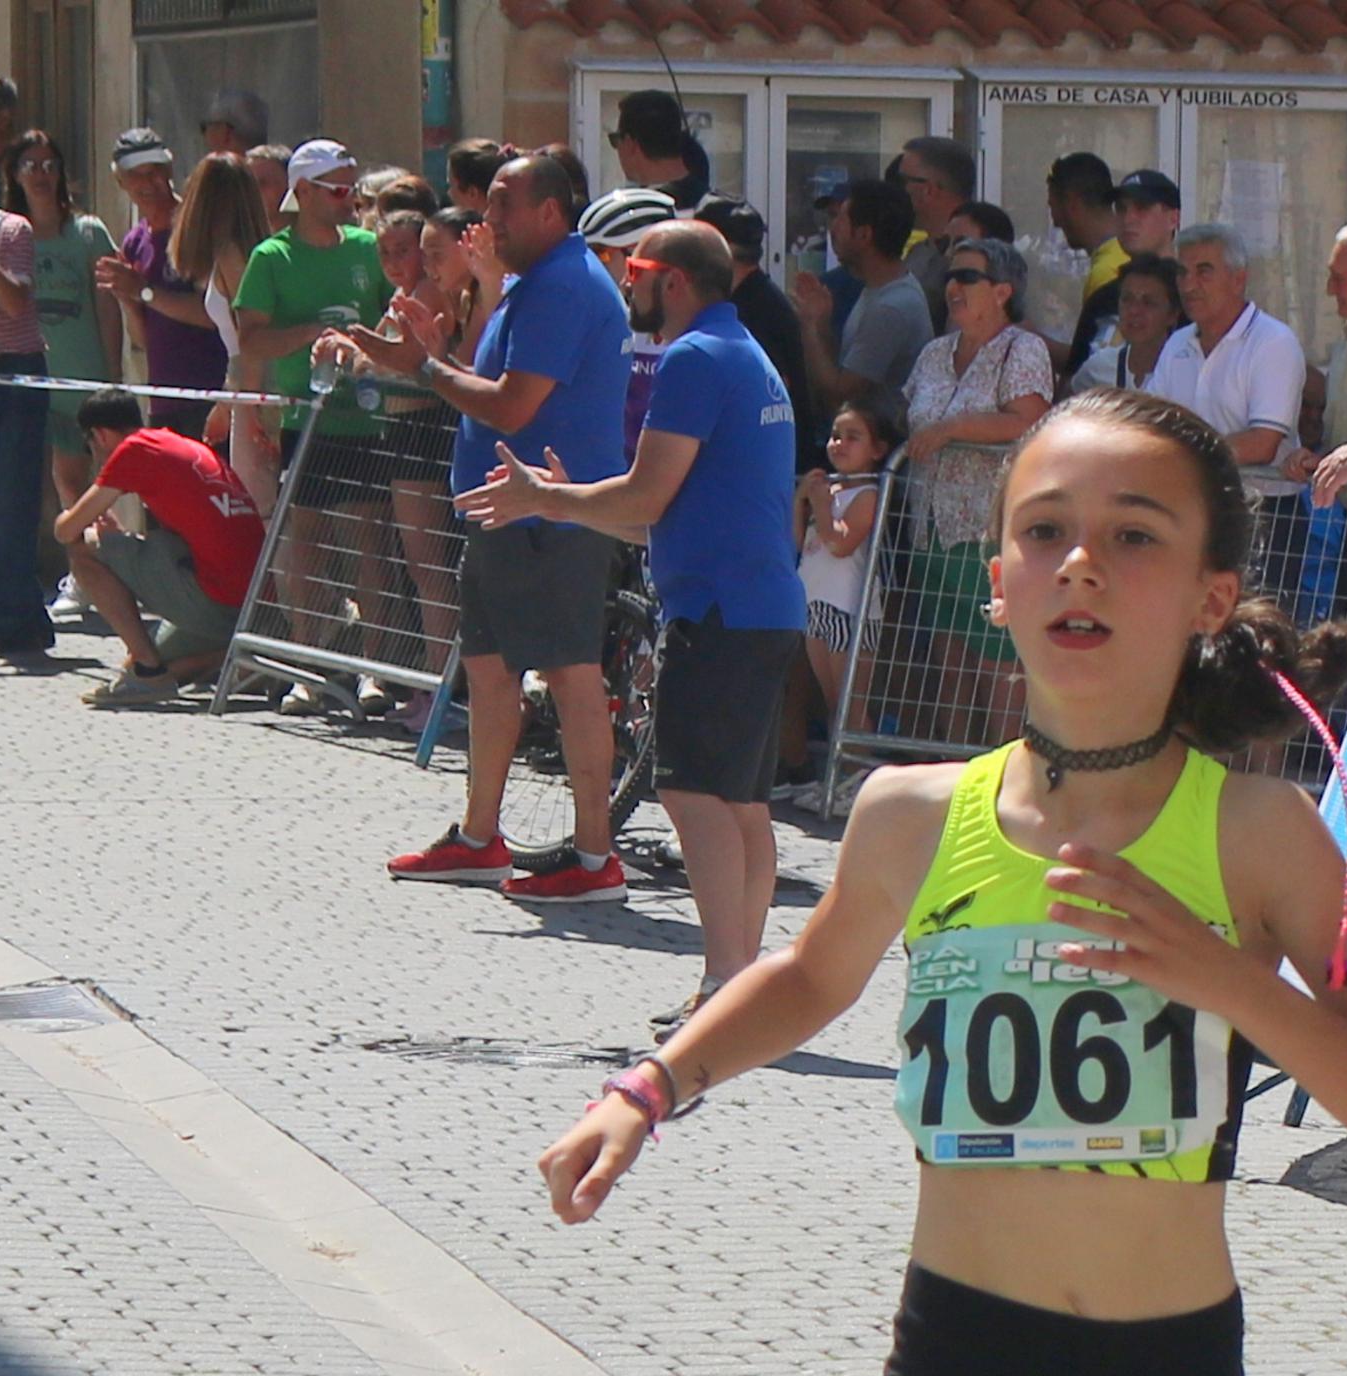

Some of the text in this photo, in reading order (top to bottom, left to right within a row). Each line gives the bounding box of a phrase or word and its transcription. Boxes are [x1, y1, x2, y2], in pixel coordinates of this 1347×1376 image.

[989, 86, 1298, 108] AMAS DE CASA Y JUBILADOS
[911, 960, 977, 979] LEN
[910, 976, 978, 993] CIA
[904, 990, 1197, 1126] 1061
